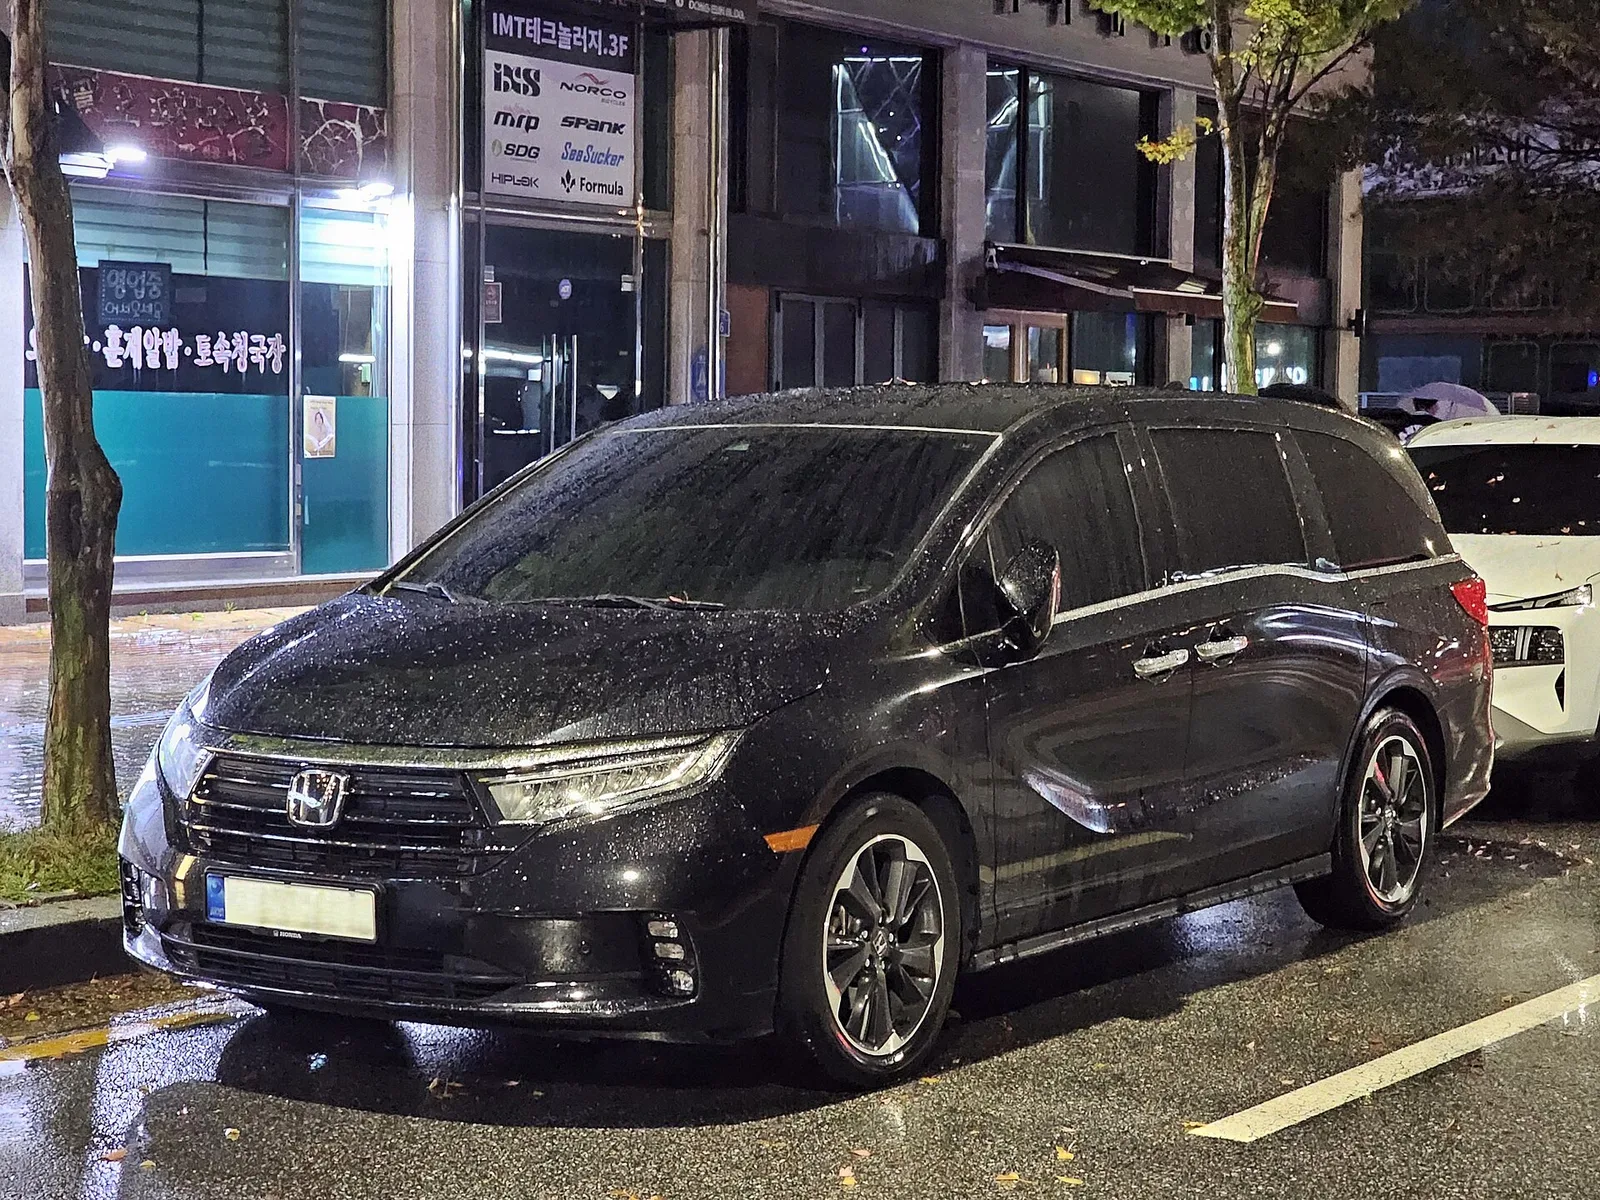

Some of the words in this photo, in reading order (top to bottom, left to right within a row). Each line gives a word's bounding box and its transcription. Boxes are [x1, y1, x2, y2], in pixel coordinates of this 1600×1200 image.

[560, 82, 627, 99] NORCO
[504, 143, 540, 159] SDG
[561, 141, 624, 167] SeaSucker
[579, 177, 624, 196] Formula
[106, 268, 163, 299] 영업중
